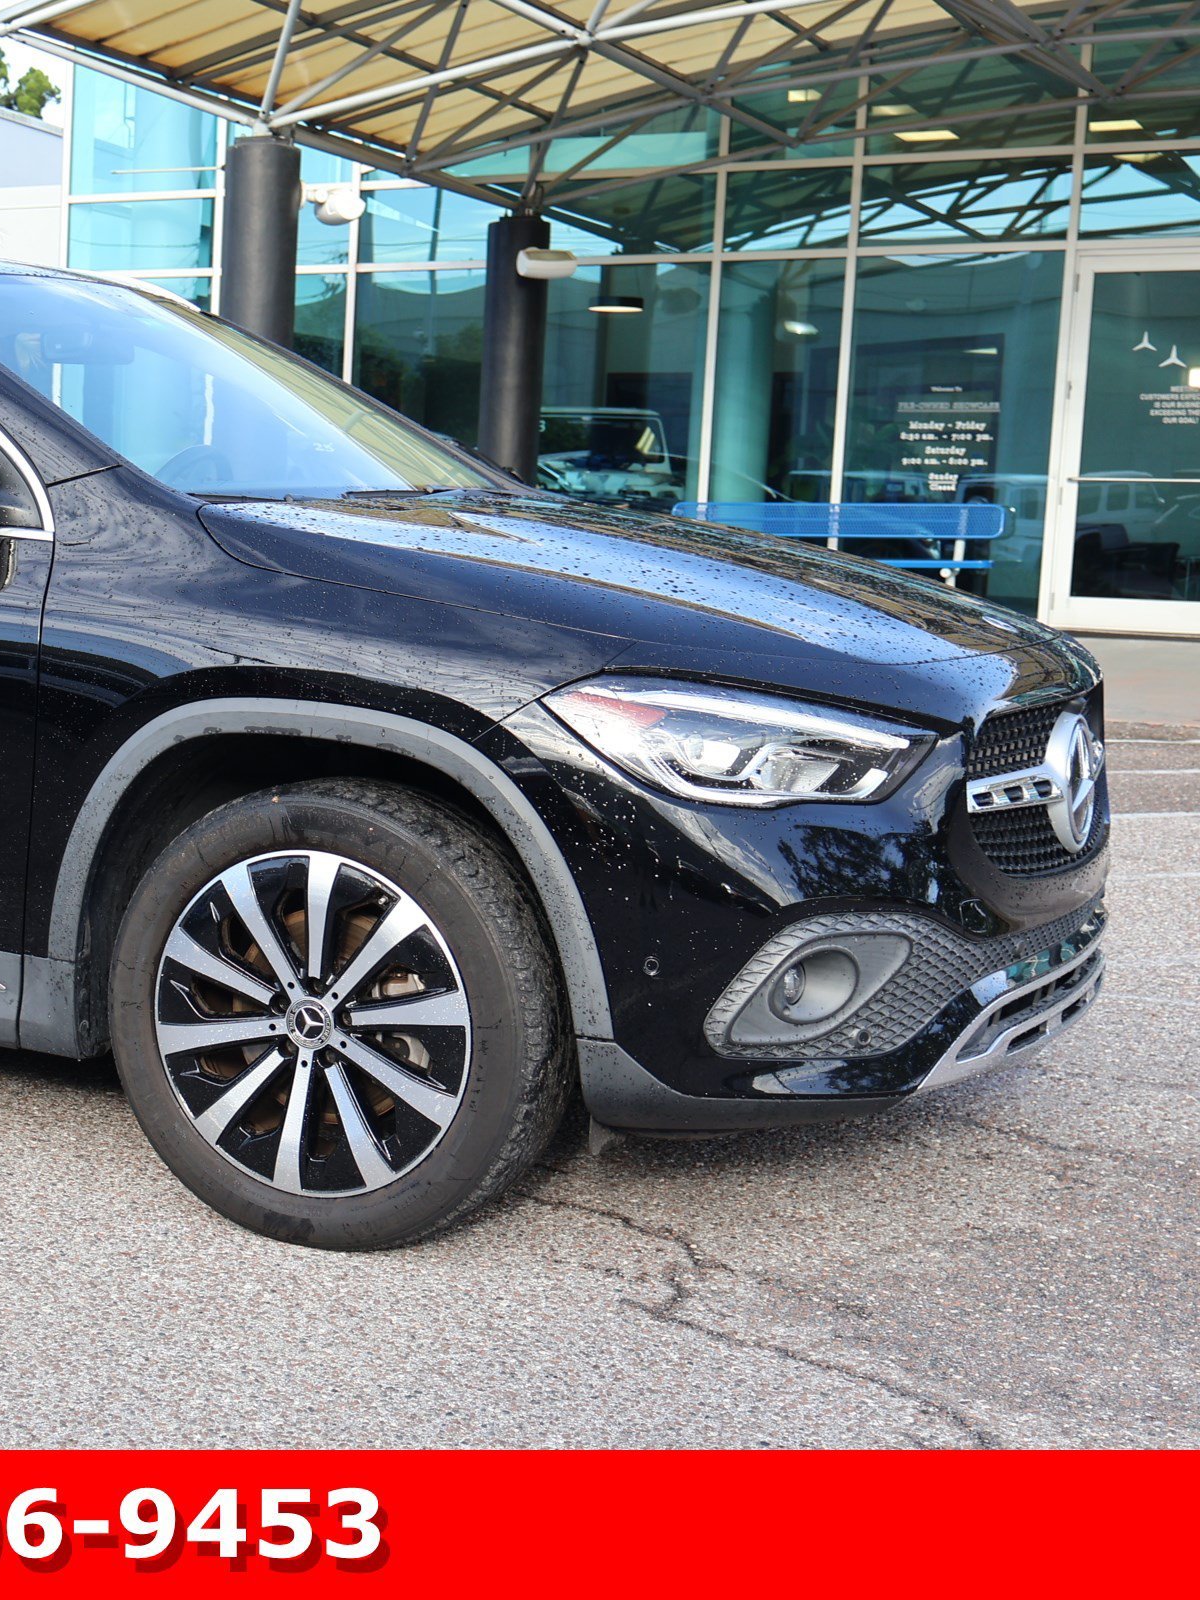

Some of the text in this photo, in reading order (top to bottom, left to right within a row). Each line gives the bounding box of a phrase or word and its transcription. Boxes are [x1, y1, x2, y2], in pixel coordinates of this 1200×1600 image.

[909, 421, 945, 431] Monday
[955, 421, 987, 431] Friday
[925, 446, 966, 456] Saturday
[928, 472, 959, 481] Sunday
